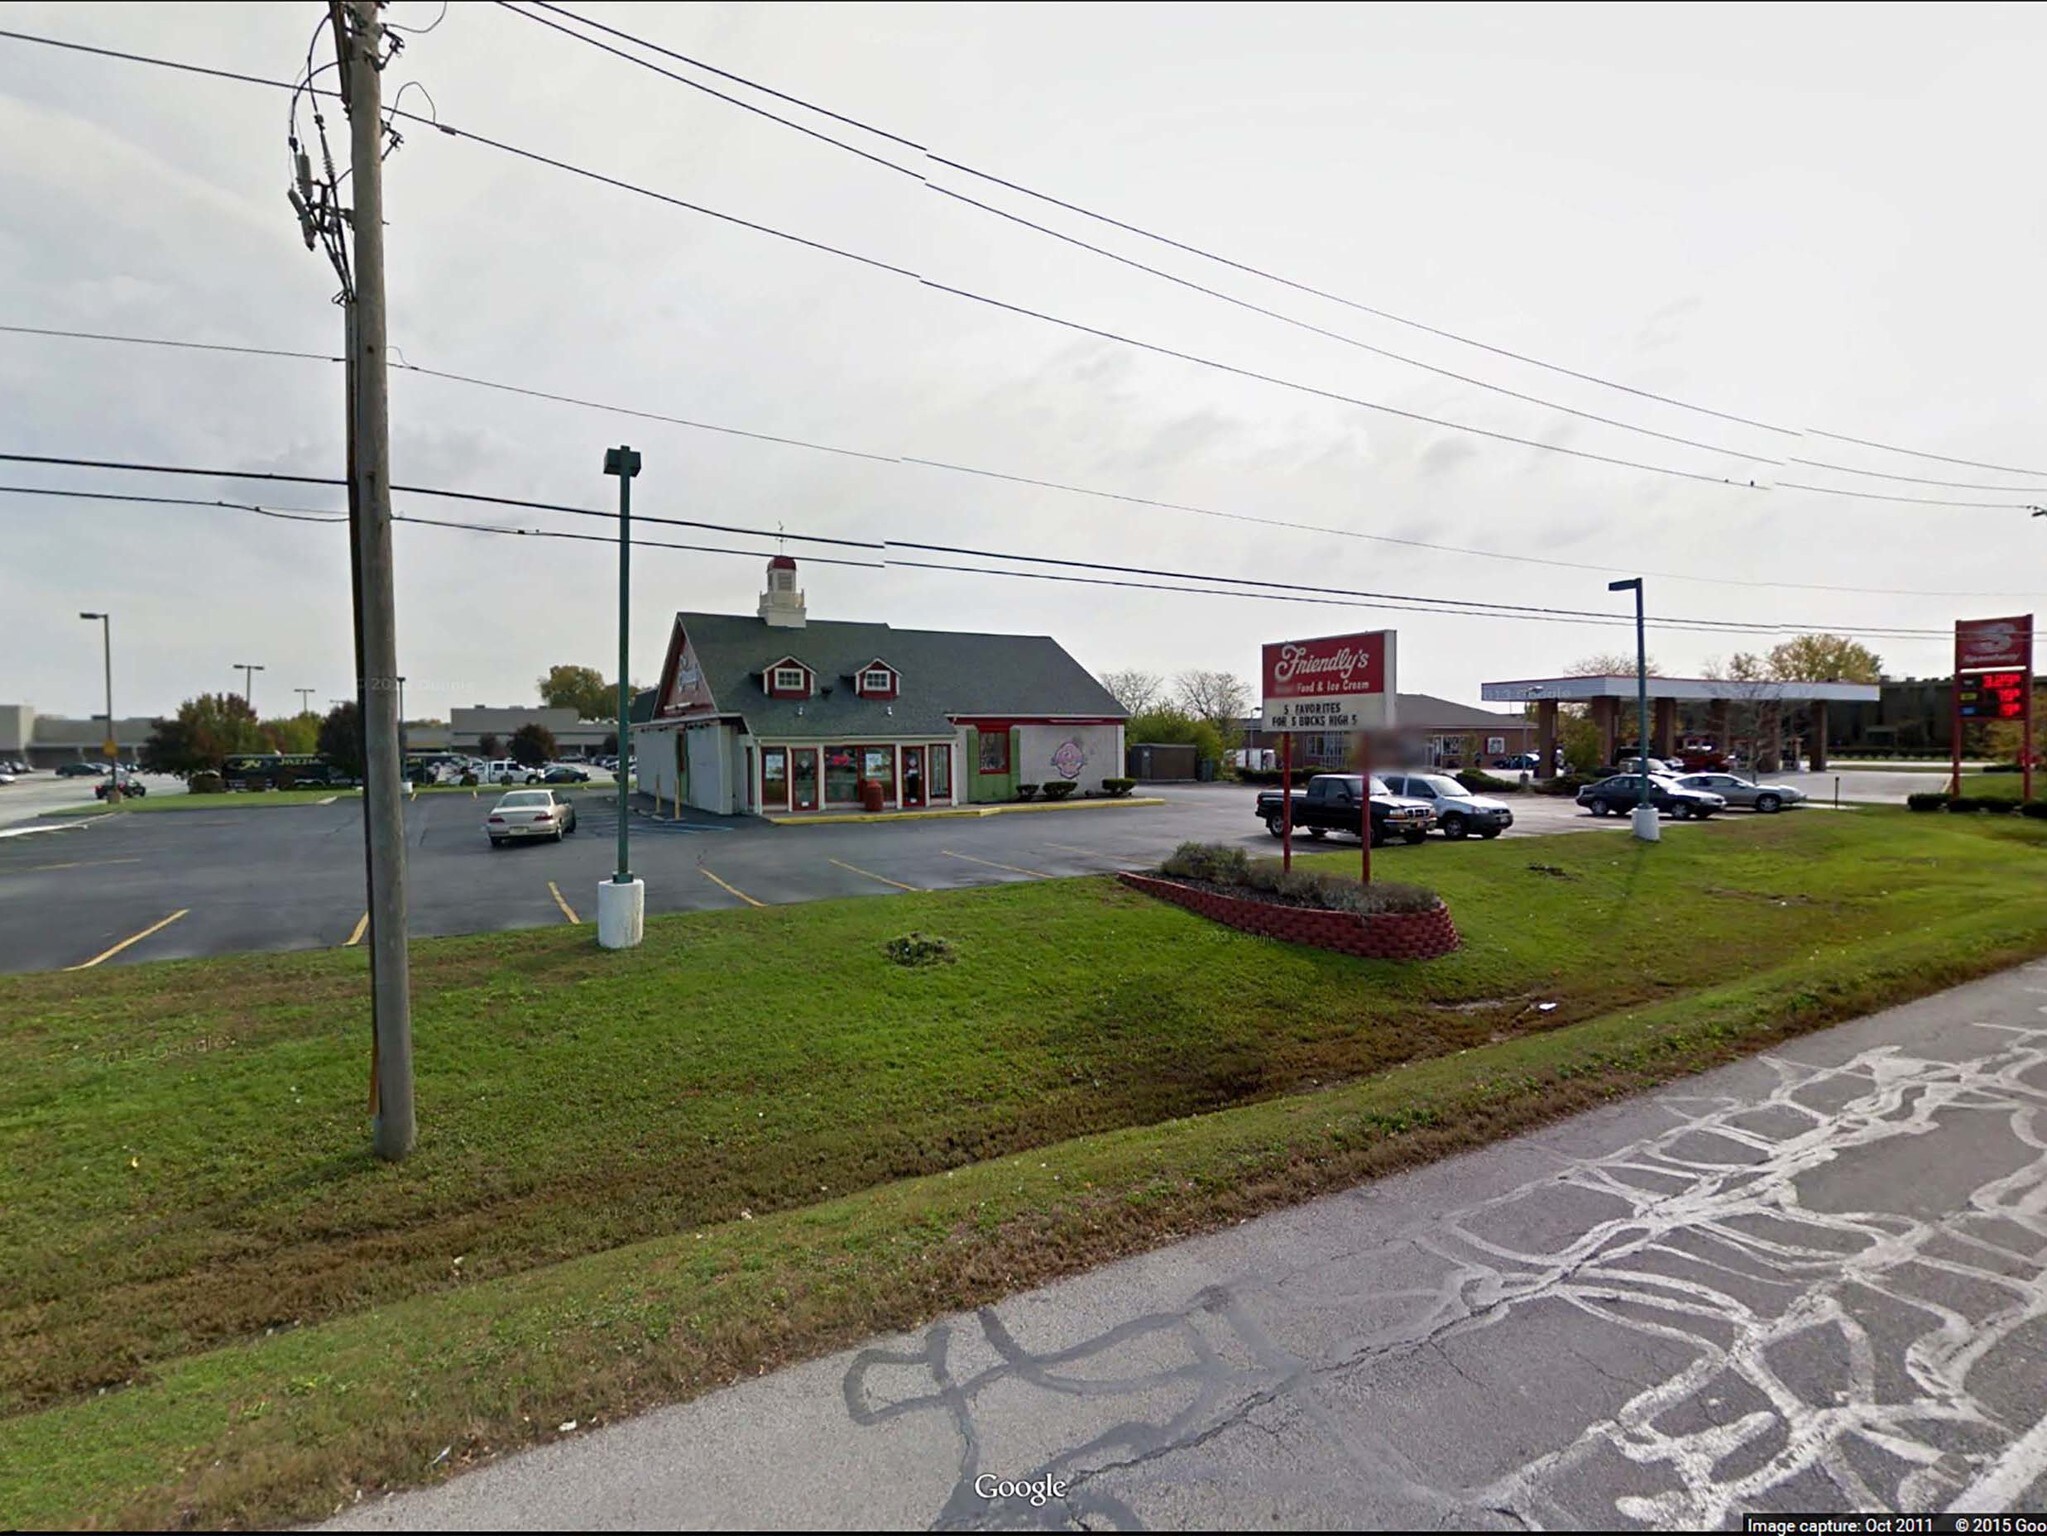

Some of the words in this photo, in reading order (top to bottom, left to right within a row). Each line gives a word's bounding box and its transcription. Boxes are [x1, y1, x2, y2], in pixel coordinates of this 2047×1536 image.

[1274, 644, 1370, 682] Friendly's
[1297, 681, 1315, 693] Food
[1317, 681, 1324, 692] &
[1327, 680, 1340, 692] Ice
[1342, 679, 1370, 691] Cream
[1295, 702, 1342, 715] FAVORITES
[1272, 716, 1287, 728] FOR
[1298, 715, 1326, 727] BUCKS
[1328, 714, 1349, 727] HIGH
